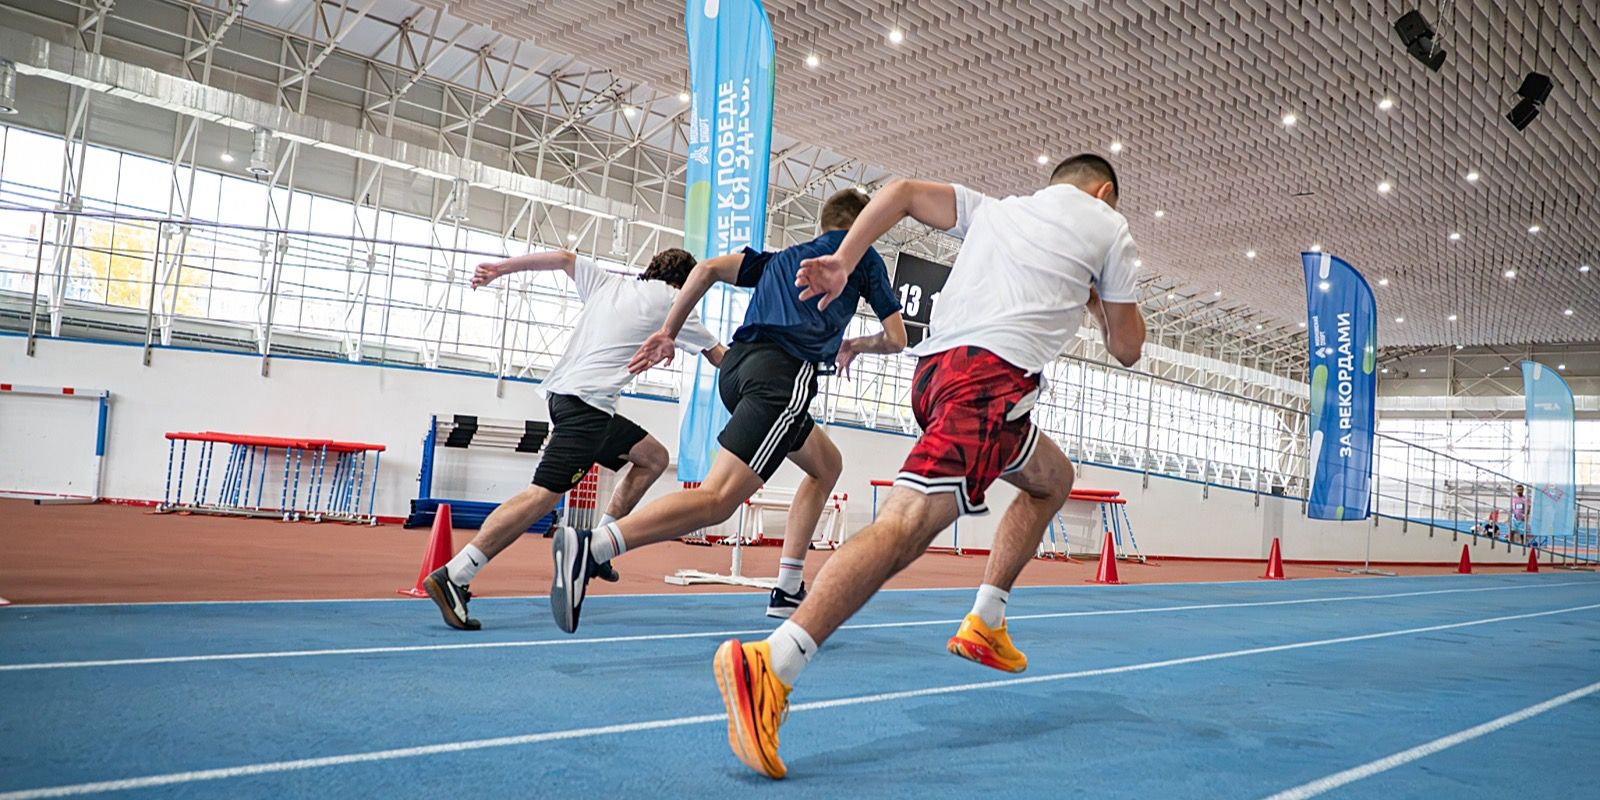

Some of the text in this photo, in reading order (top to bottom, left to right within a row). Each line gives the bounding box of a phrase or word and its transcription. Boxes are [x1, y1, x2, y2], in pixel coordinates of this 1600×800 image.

[717, 79, 738, 256] ИЕ К ПОБЕДЕ
[898, 283, 922, 317] 13
[1337, 312, 1354, 458] ЗА РЕКОРДАМИ
